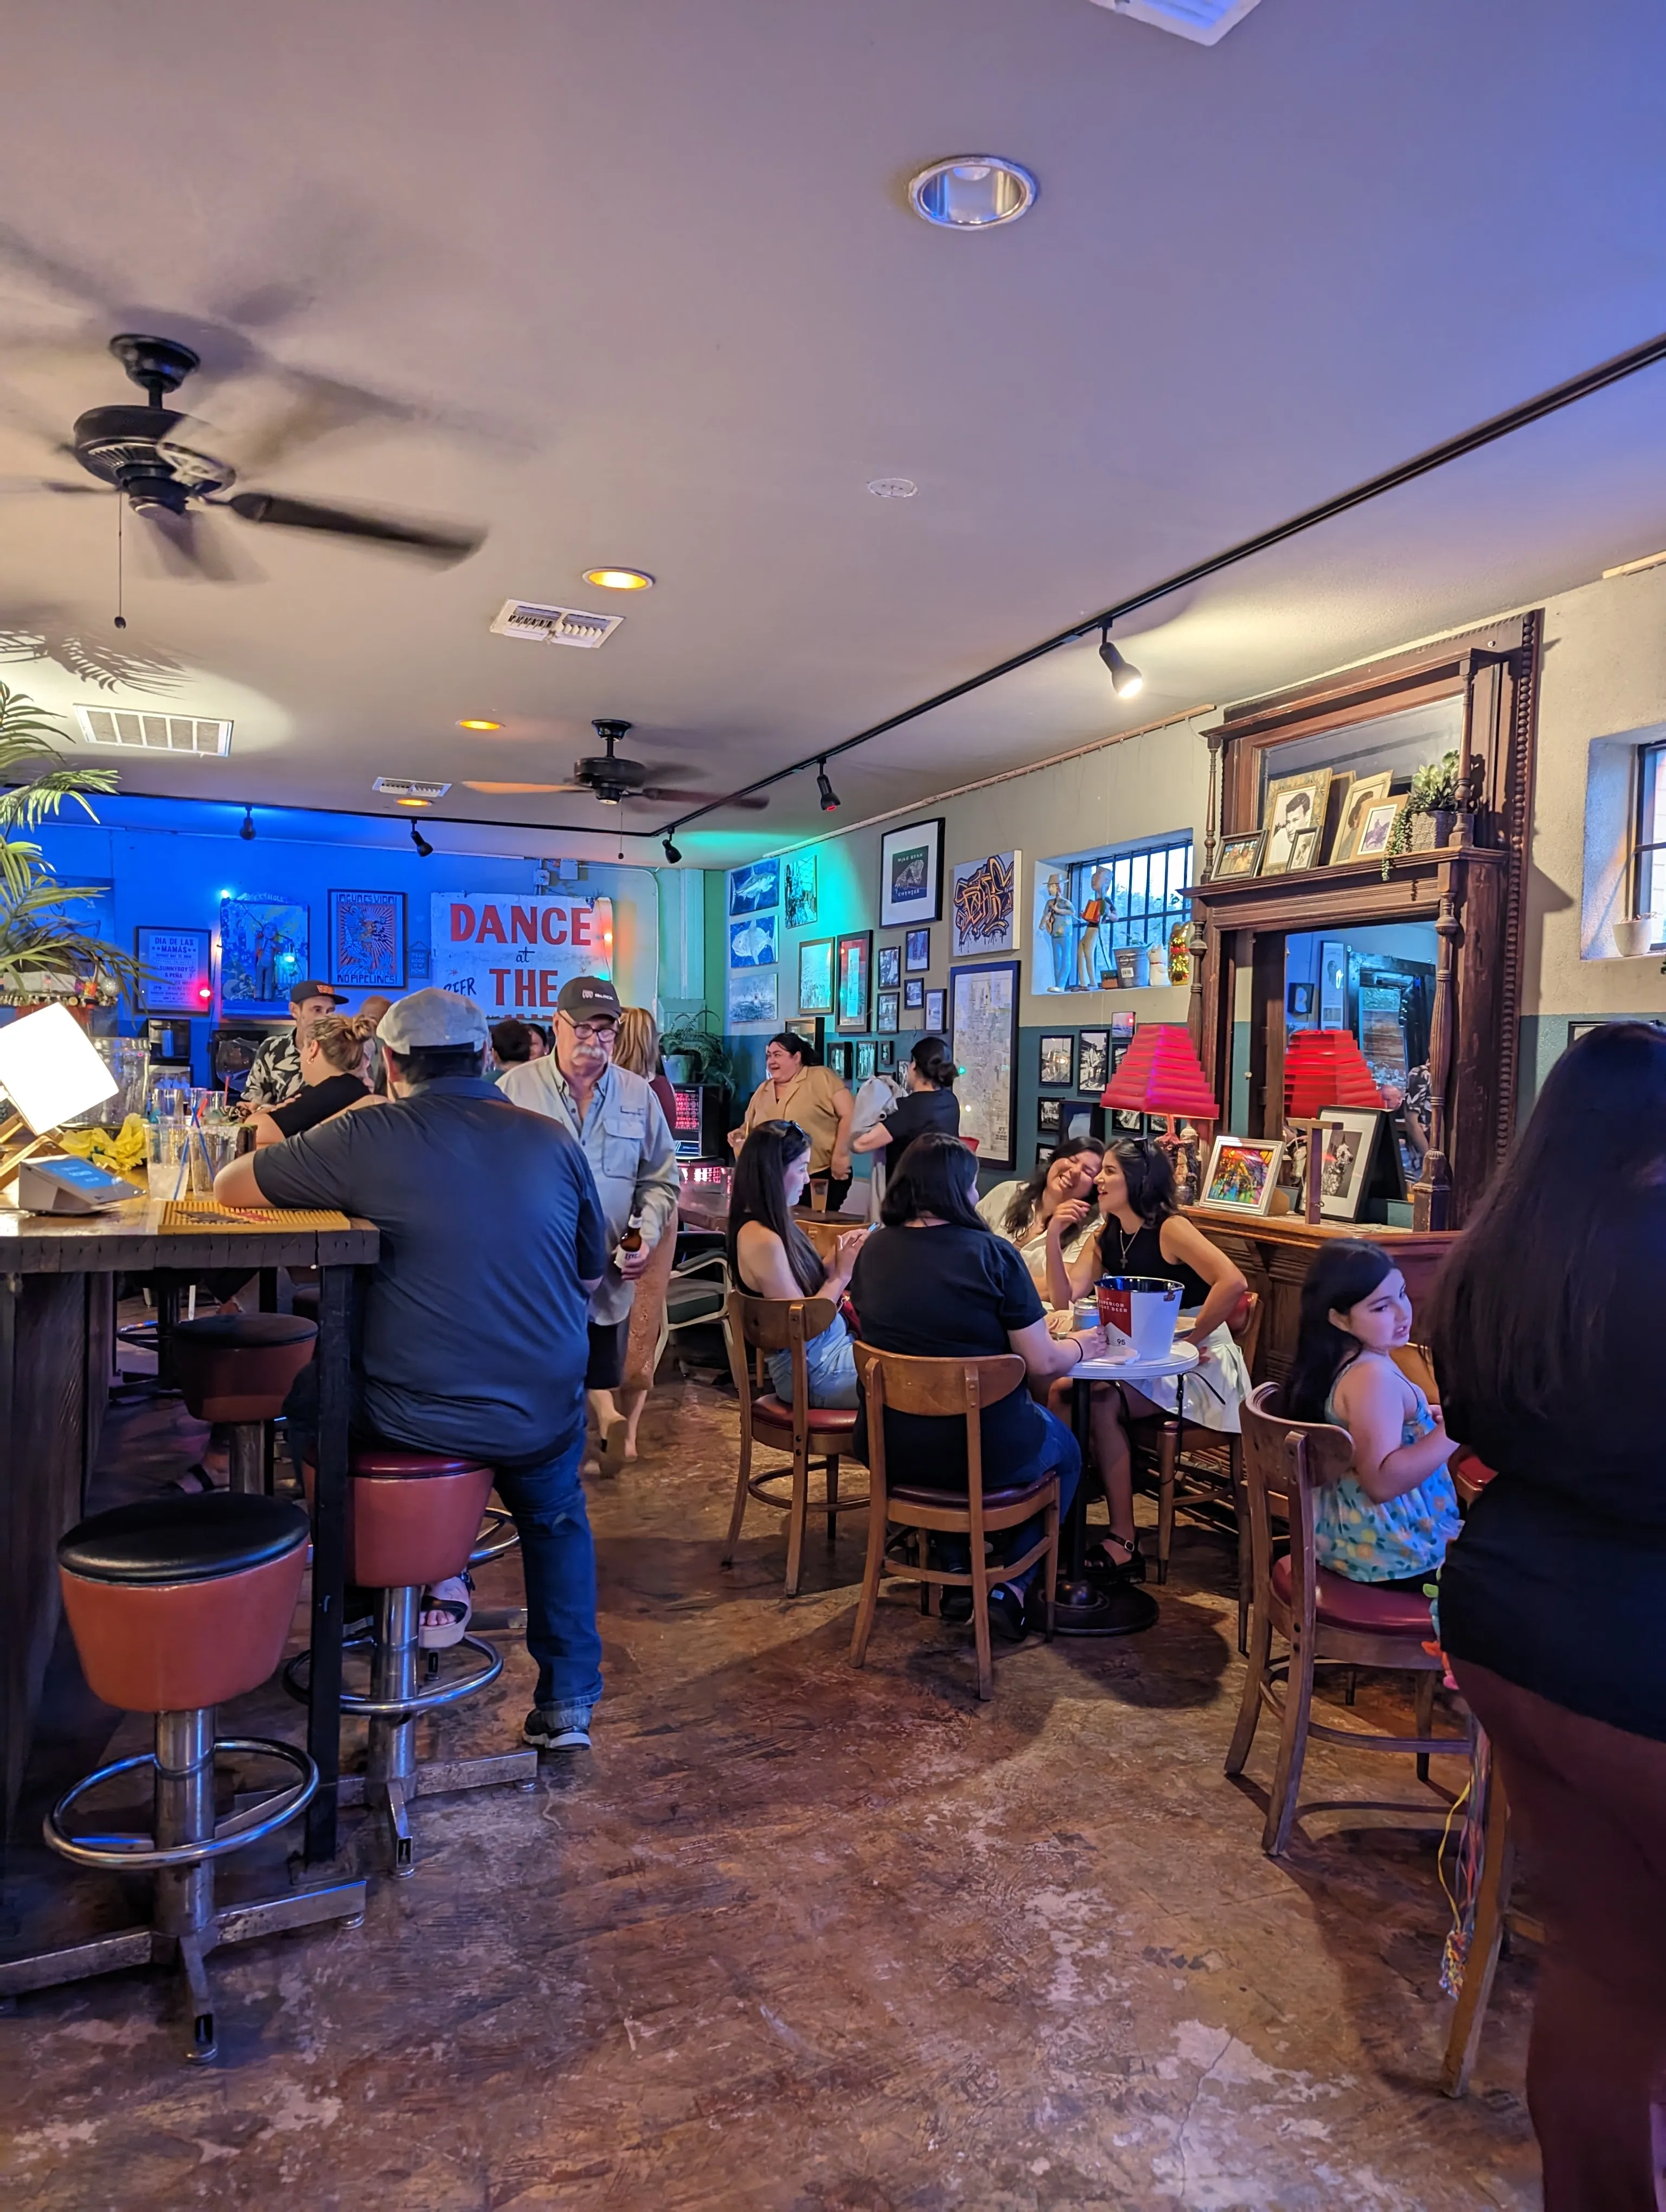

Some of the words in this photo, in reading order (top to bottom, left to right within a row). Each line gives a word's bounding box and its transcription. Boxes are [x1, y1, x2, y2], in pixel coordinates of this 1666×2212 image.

[898, 889, 920, 897] COYOTES
[450, 903, 592, 946] DANCE
[516, 947, 535, 963] at
[337, 974, 349, 982] NO
[489, 968, 558, 1007] THE
